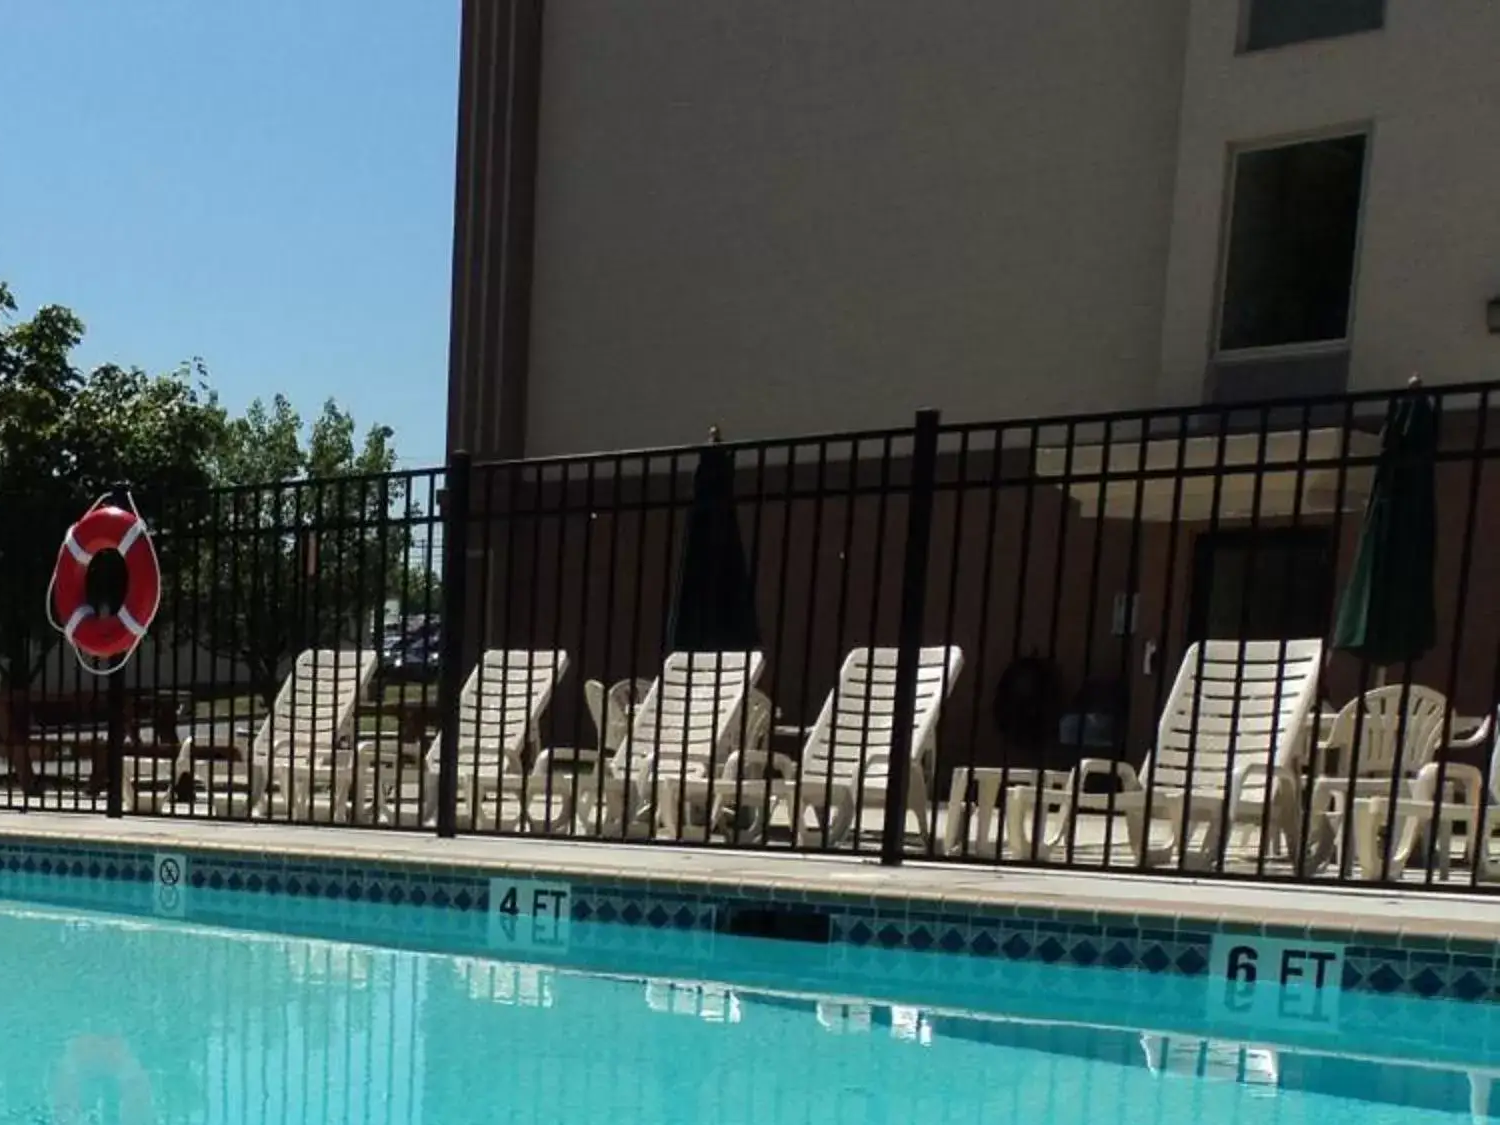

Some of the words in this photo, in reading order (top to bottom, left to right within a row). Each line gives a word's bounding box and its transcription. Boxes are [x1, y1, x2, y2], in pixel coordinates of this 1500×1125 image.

[499, 886, 519, 916] 4
[532, 888, 567, 920] FT
[1226, 945, 1259, 984] 6
[1280, 949, 1336, 989] FT
